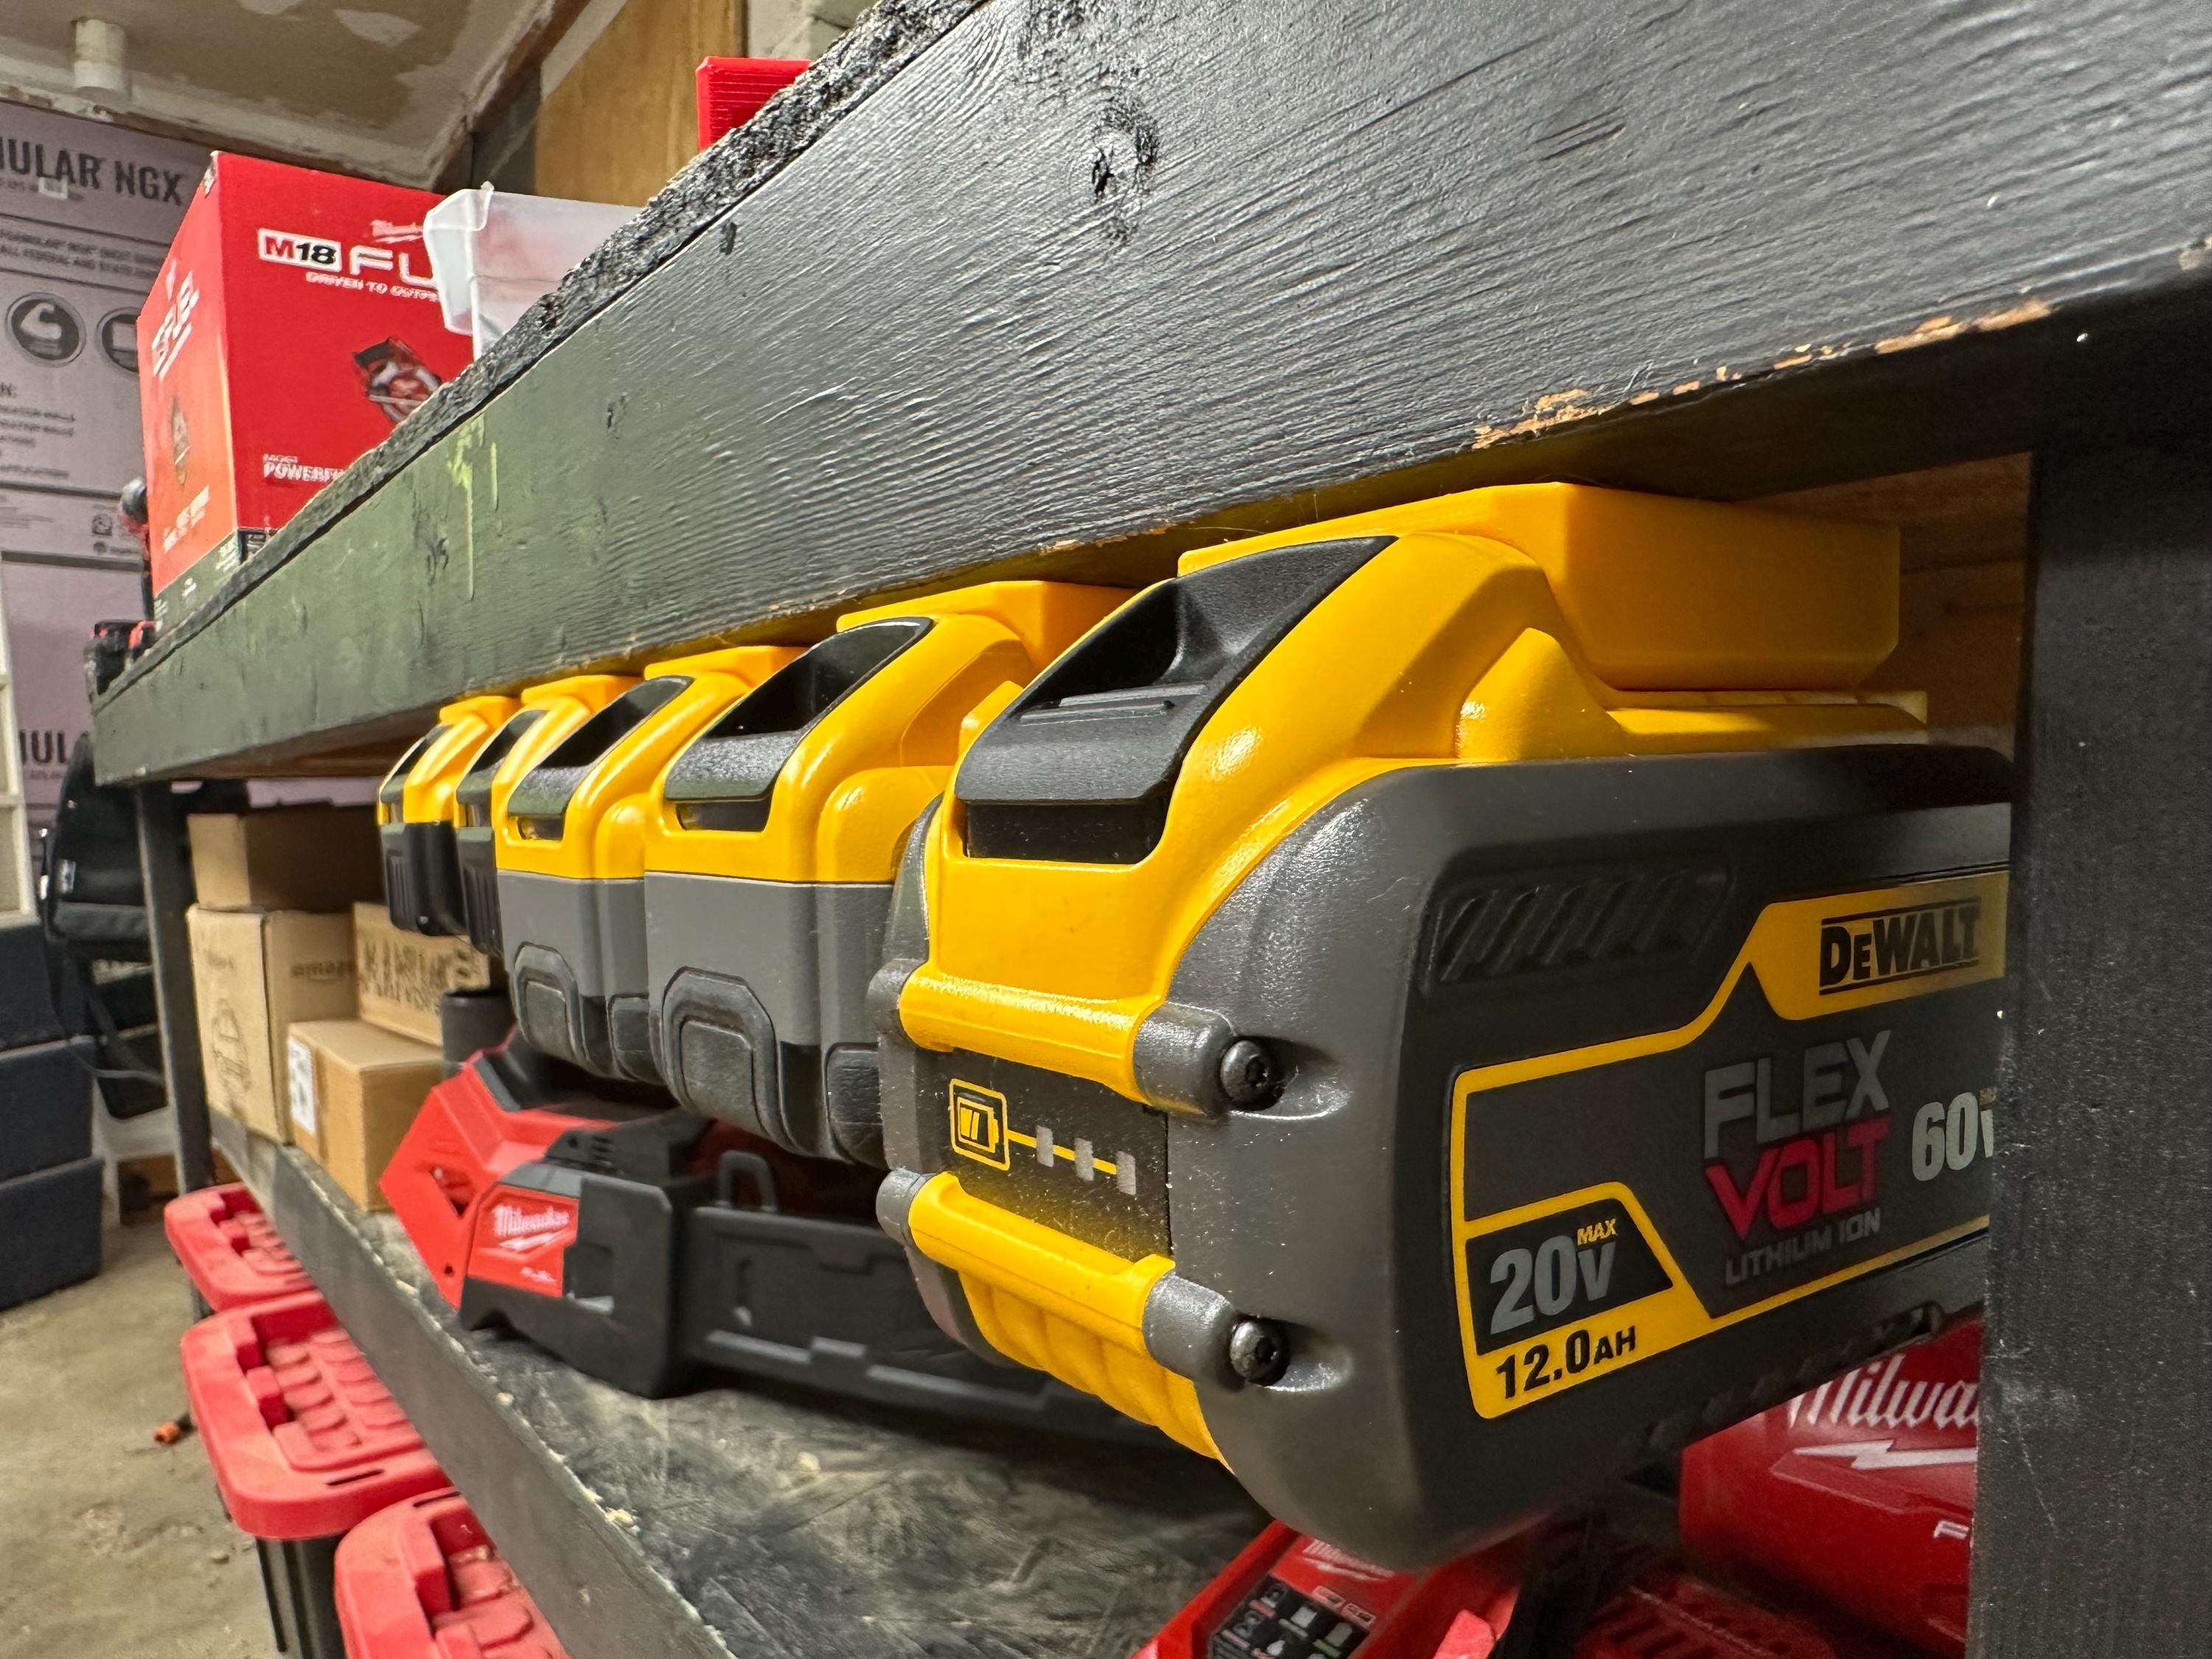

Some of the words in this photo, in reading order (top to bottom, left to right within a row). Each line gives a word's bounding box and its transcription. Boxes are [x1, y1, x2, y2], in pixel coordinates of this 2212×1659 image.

[114, 161, 183, 206] NGX
[264, 234, 337, 264] M18
[366, 282, 389, 294] TO
[1819, 904, 1980, 987] DEWALT
[1704, 1029, 1892, 1160] FLEX
[1705, 1113, 1892, 1242] VOLT
[1576, 1218, 1618, 1246] MAX
[1725, 1224, 1833, 1287] LITHIUM
[1836, 1207, 1882, 1246] ION
[1489, 1235, 1616, 1335] 20V
[1496, 1326, 1637, 1399] 12.0AH
[1787, 1353, 1978, 1430] Milwa
